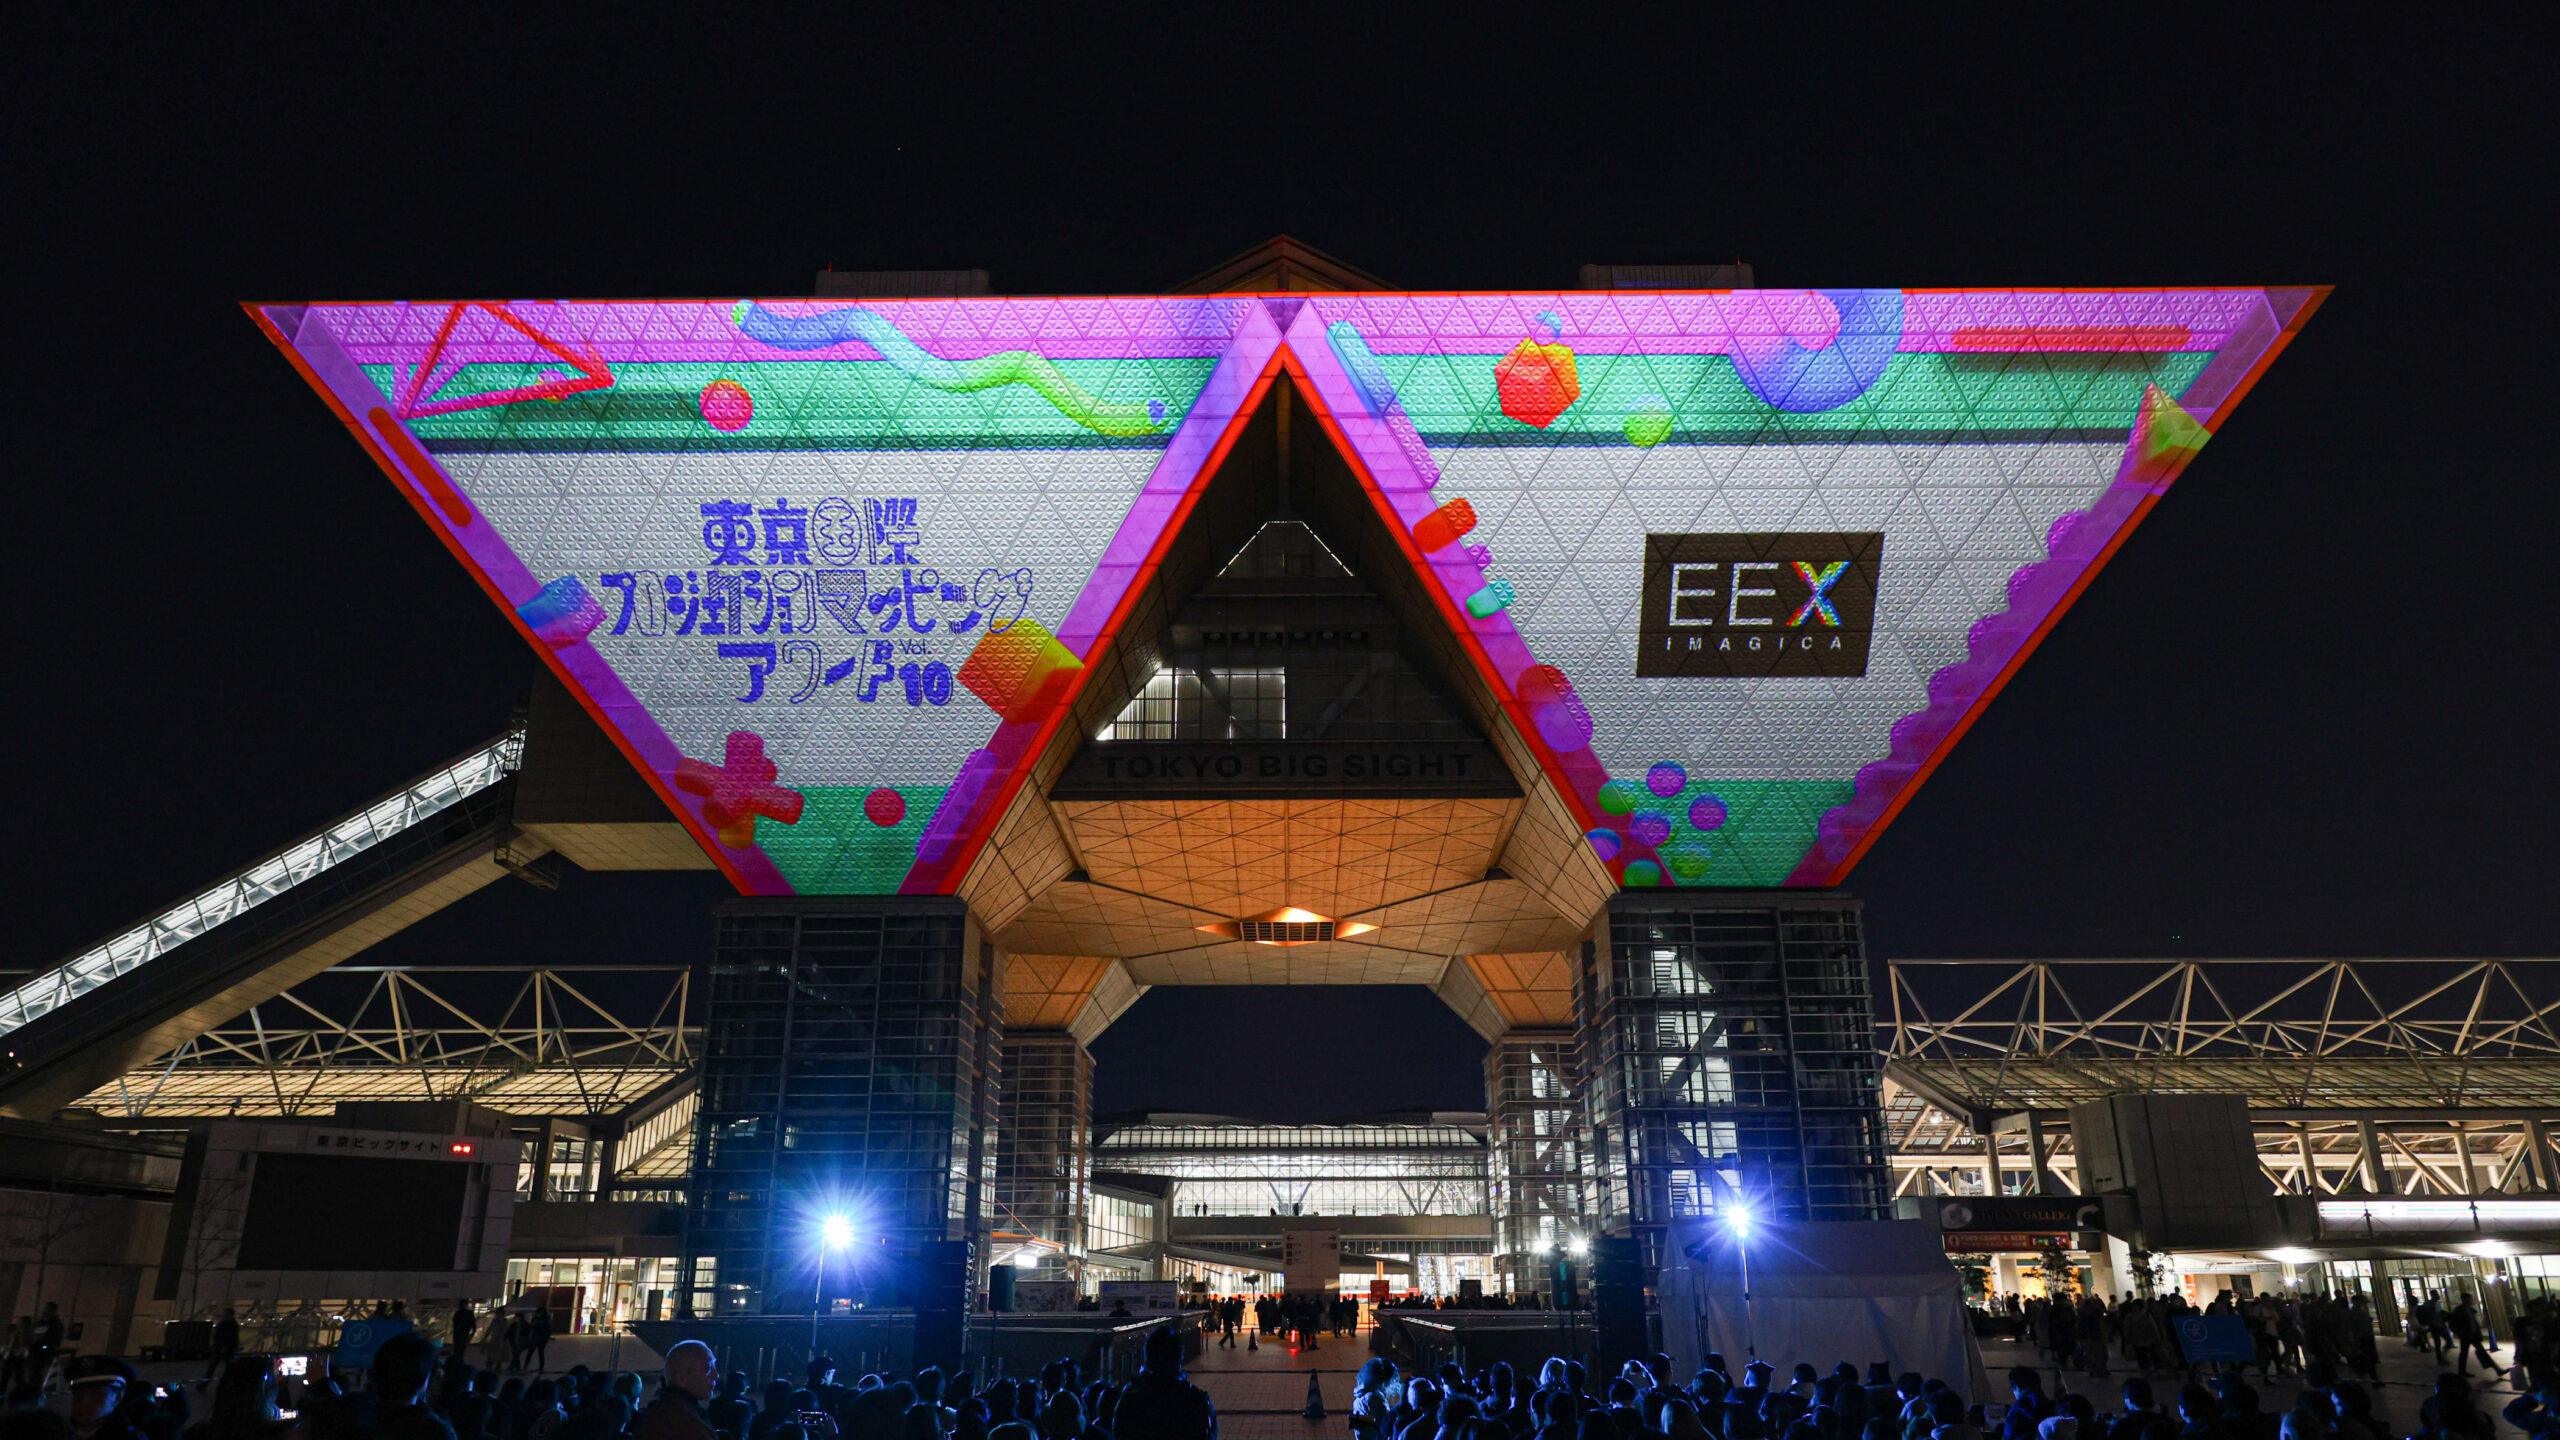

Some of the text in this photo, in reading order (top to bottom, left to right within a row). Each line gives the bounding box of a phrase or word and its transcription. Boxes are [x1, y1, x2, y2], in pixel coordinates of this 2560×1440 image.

[700, 497, 920, 565] 東京国際
[1669, 561, 1850, 626] EEX
[1666, 636, 1842, 651] IMAGICA
[717, 639, 895, 704] アワード
[899, 639, 954, 707] Vol. 10
[1101, 753, 1474, 779] TOKYO BIG SIGHT
[316, 1135, 440, 1153] 東京ビッグサイト
[2023, 1209, 2071, 1221] GALLERY
